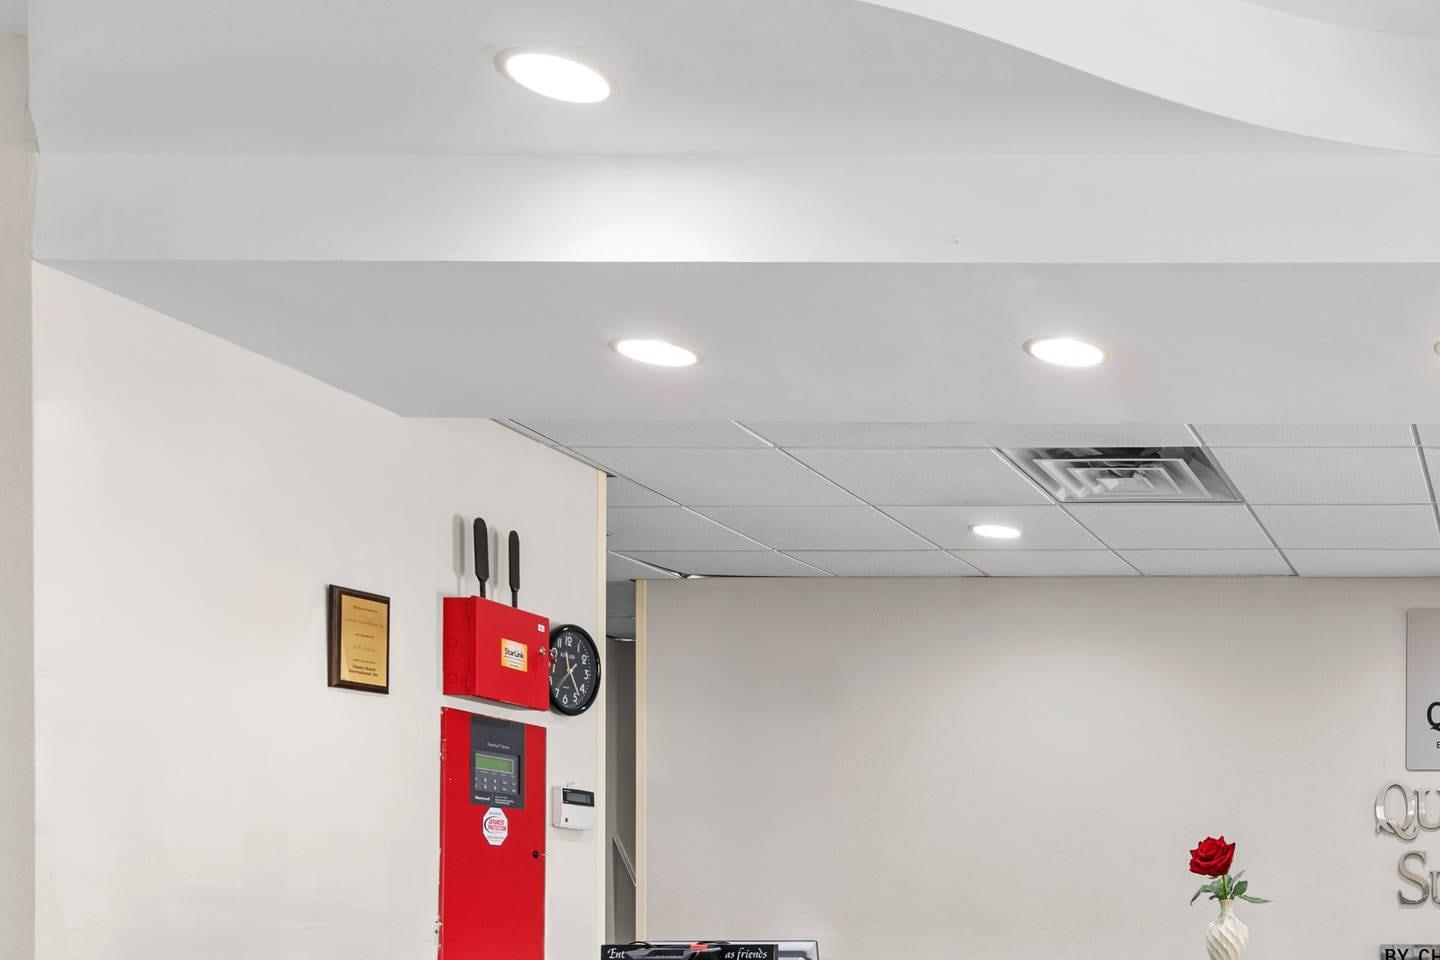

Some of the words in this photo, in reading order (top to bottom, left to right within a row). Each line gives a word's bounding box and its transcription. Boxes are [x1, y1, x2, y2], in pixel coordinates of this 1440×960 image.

[565, 636, 574, 647] 12
[581, 654, 587, 665] 2
[584, 669, 589, 680] 3
[563, 694, 568, 704] 6
[607, 947, 626, 960] Ent
[724, 951, 734, 960] as
